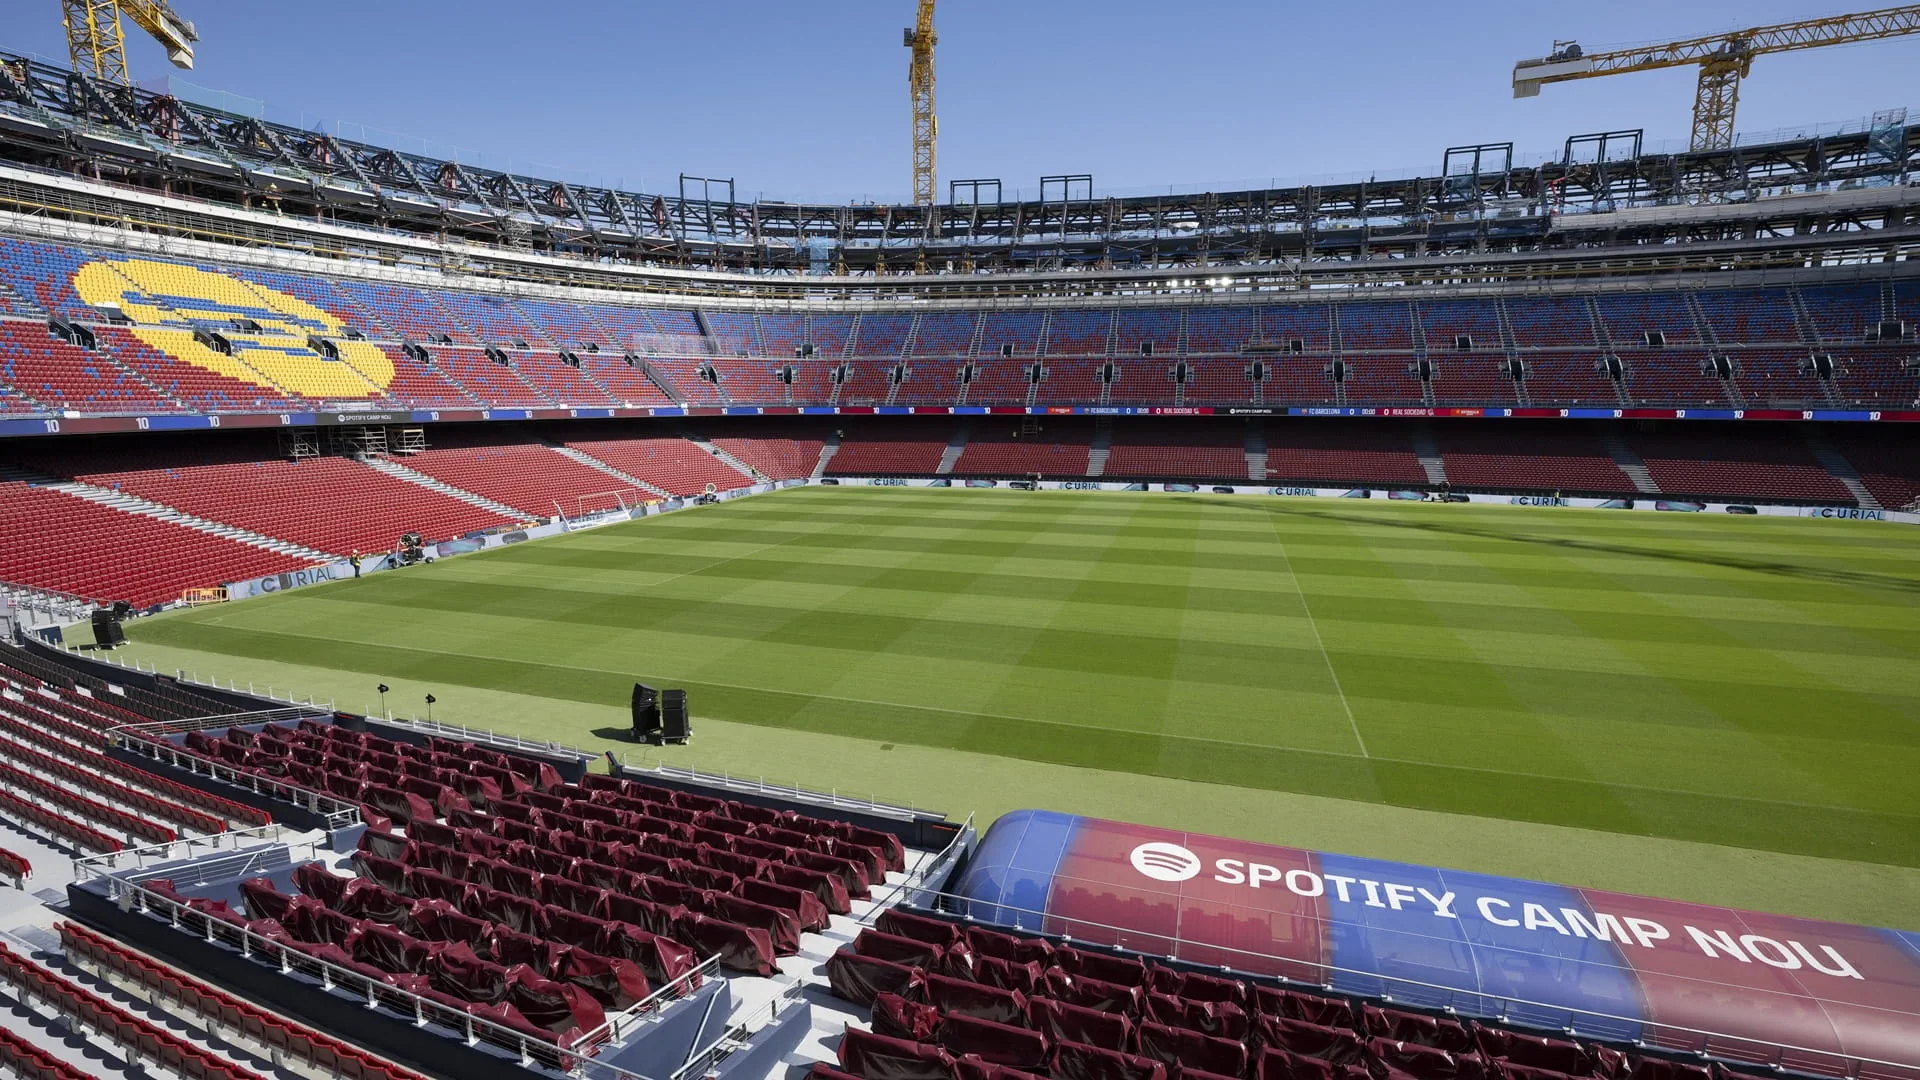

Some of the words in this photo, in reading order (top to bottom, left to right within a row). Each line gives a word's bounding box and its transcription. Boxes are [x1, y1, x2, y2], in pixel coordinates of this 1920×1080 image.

[280, 415, 290, 424] 10
[1803, 411, 1812, 419] 10
[1870, 412, 1880, 420] 10
[44, 420, 59, 432] 10
[136, 418, 149, 429] 10
[208, 416, 220, 427] 10
[874, 478, 908, 486] CURIAL
[1065, 482, 1102, 490] CURIAL
[1275, 487, 1316, 496] CURIAL
[1821, 508, 1885, 520] CURIAL
[1215, 859, 1456, 918] SPOTIFY
[1477, 897, 1669, 947] CAMP
[1684, 926, 1864, 979] NOU
